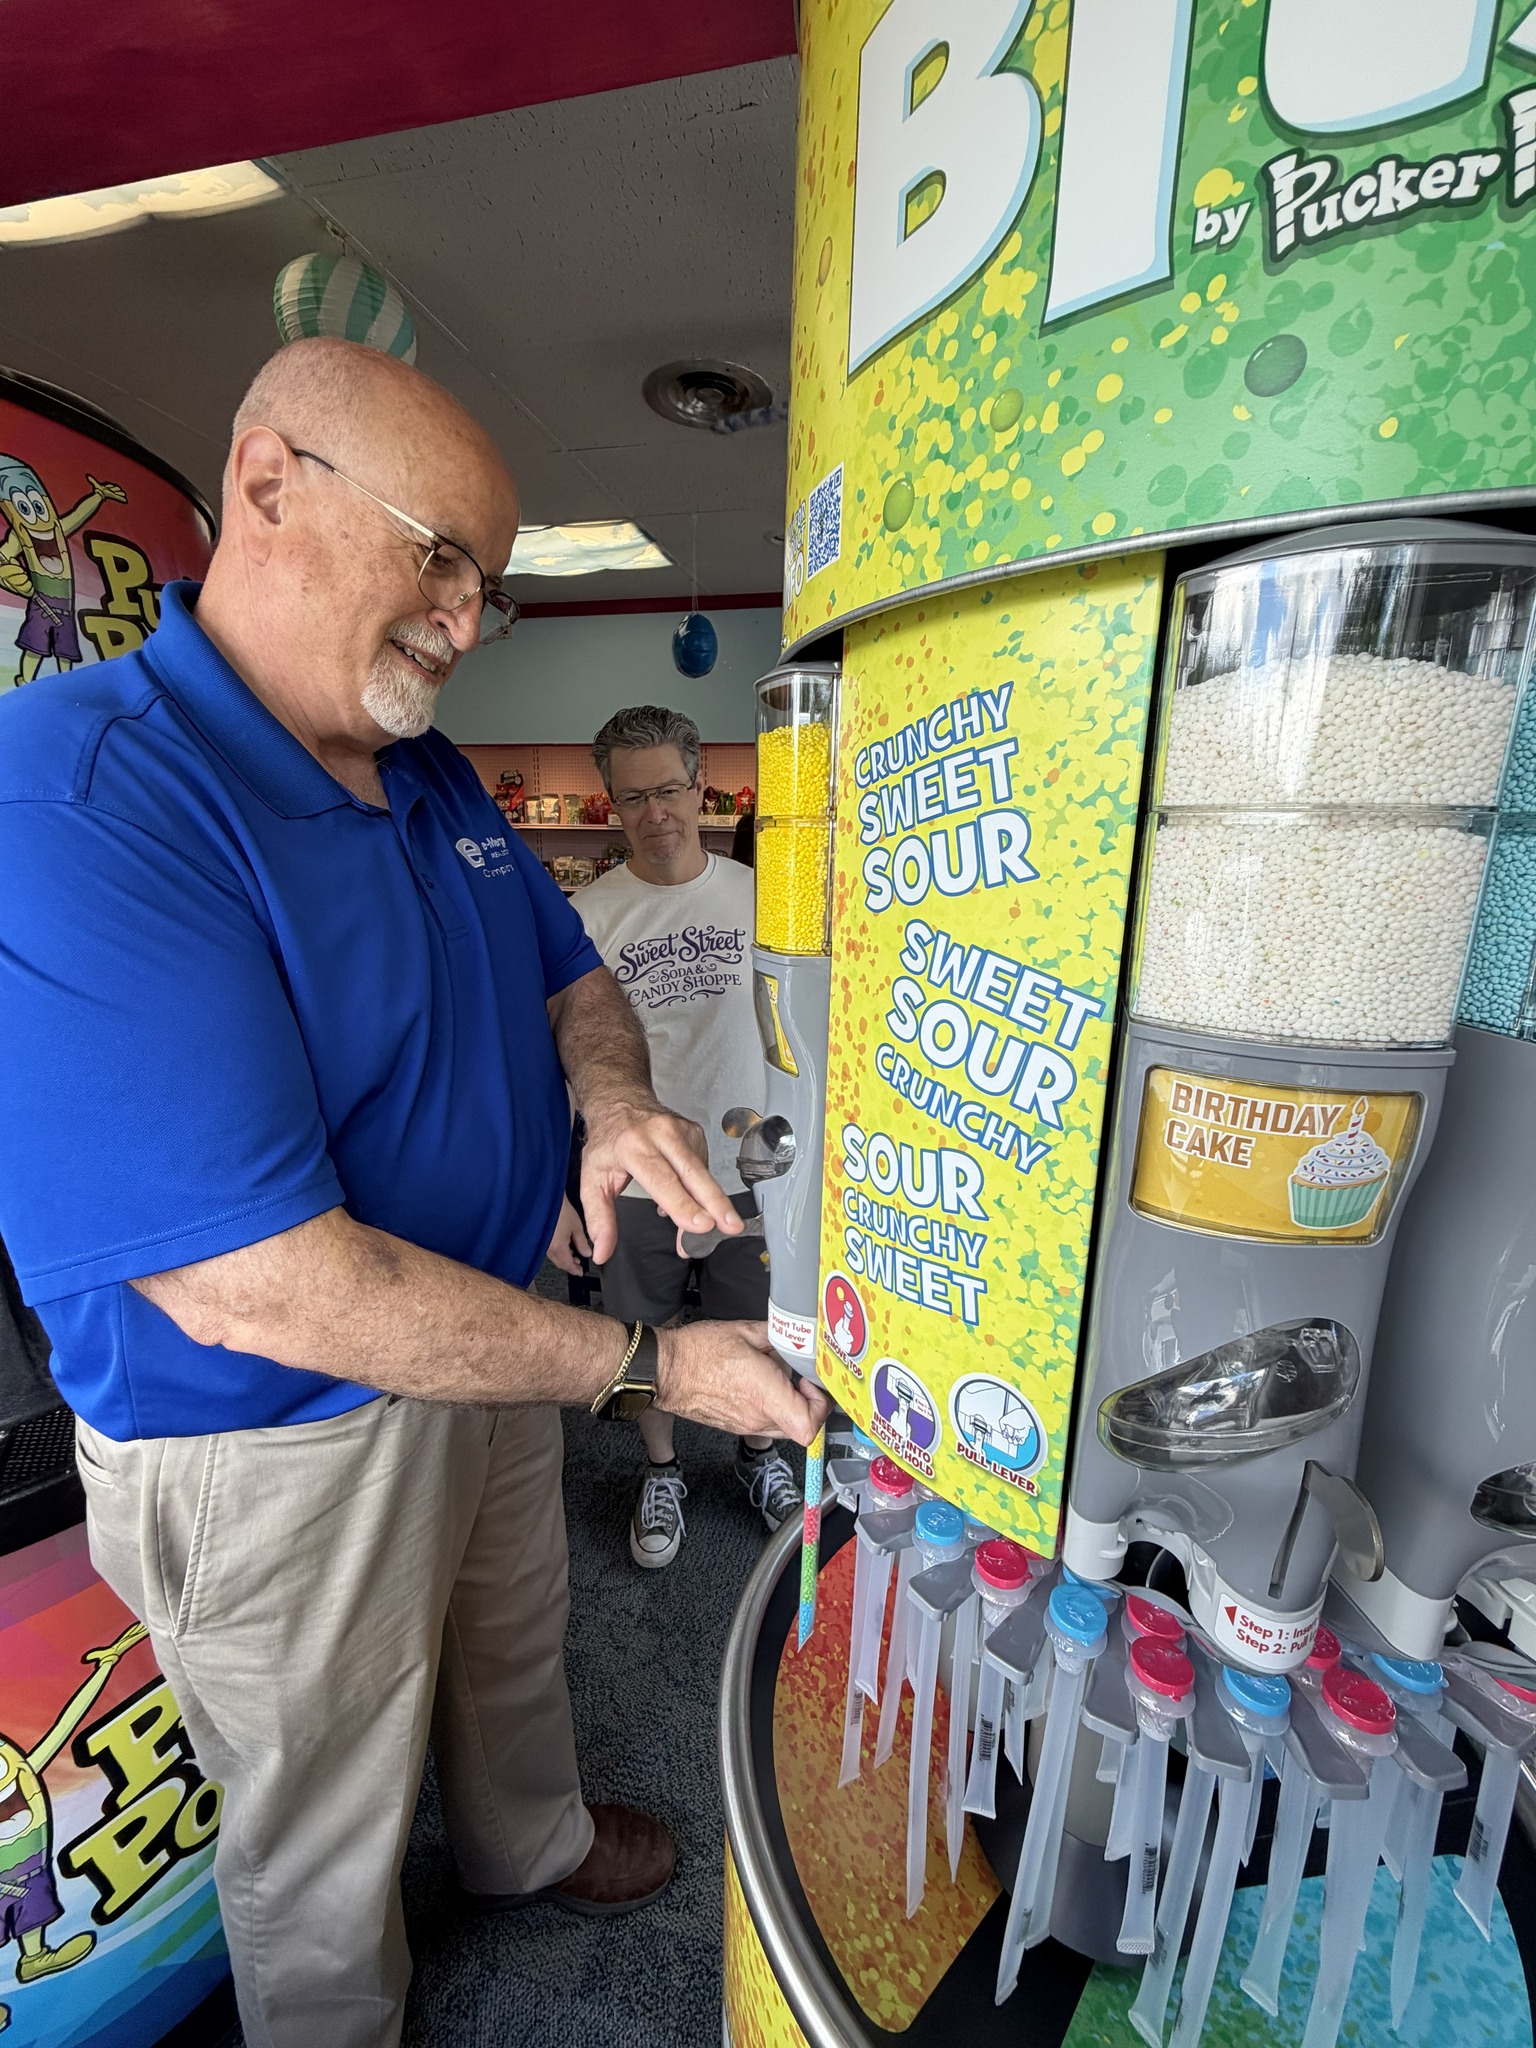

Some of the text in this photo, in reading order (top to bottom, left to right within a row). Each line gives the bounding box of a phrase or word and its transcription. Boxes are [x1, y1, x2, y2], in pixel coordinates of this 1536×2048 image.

[1194, 153, 1501, 255] by Pucker
[854, 681, 1014, 790] CRUNCHY
[858, 738, 1018, 846] SWEET
[862, 808, 1040, 913] SOUR
[615, 925, 746, 984] Sweet Street
[660, 964, 706, 982] SODA &
[628, 974, 741, 1007] CANDY SHOPPE
[900, 918, 1105, 1051] SWEET
[886, 975, 1075, 1130] SOUR
[875, 1042, 1051, 1175] CRUNCHY
[1170, 1080, 1346, 1138] BIRTHDAY
[842, 1123, 989, 1221] SOUR
[1164, 1118, 1256, 1168] CAKE
[842, 1187, 986, 1269] CRUNCHY
[844, 1226, 987, 1326] SWEET
[772, 1313, 811, 1335] Insert Tube
[772, 1323, 806, 1343] Pull Lever
[823, 1330, 863, 1377] REMOVE TOP
[870, 1420, 892, 1446] SLOT
[904, 1453, 934, 1477] HOLD
[873, 1411, 932, 1463] INSERT INTO
[957, 1441, 1038, 1495] PULL LEVER
[1236, 1628, 1270, 1653] Step
[1272, 1643, 1287, 1654] 2:
[1240, 1615, 1273, 1639] Step
[1278, 1629, 1290, 1640] 1:
